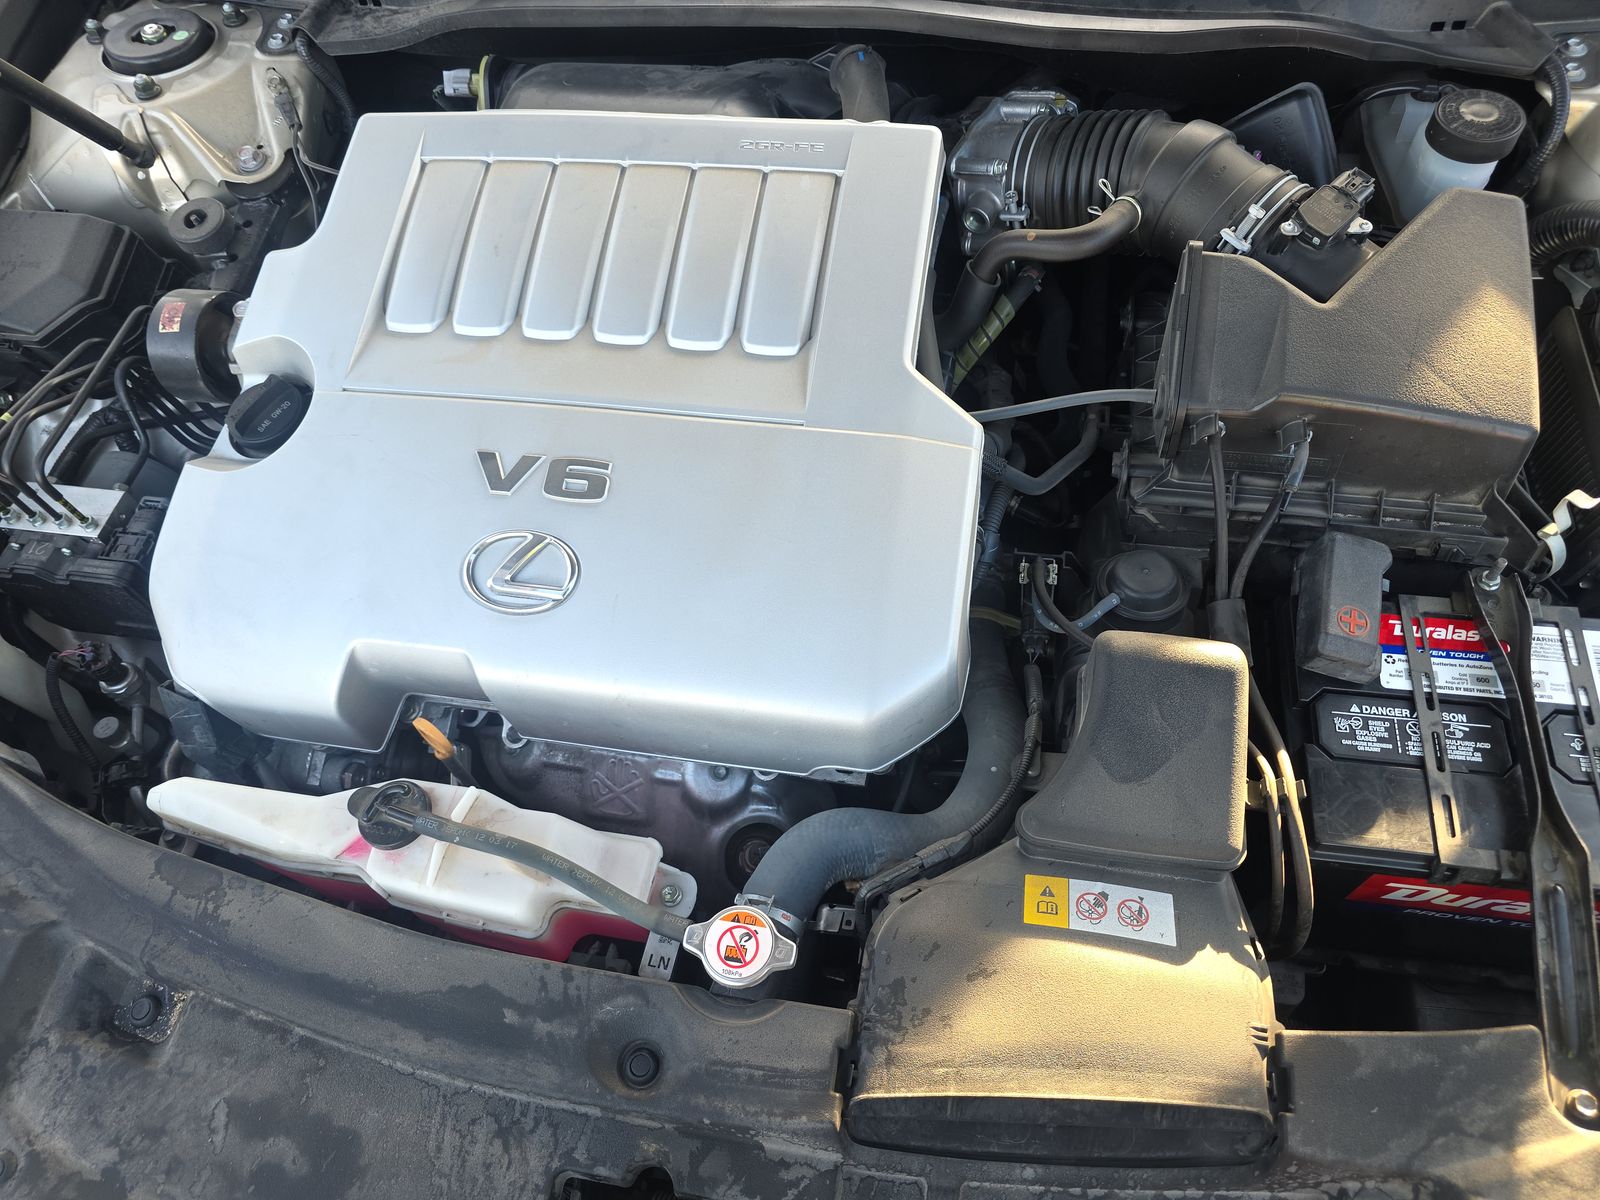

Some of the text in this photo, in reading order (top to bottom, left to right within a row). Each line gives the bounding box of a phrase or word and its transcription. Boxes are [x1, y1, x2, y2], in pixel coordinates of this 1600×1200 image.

[739, 139, 825, 153] 2GR-FE
[257, 419, 272, 433] SAE
[475, 449, 614, 503] V6
[1388, 619, 1480, 642] Duralas
[1449, 651, 1484, 660] TOUGH
[1466, 663, 1493, 671] AutoZone
[1362, 705, 1467, 723] DANGER SON
[1368, 720, 1390, 728] SHIELD
[1369, 725, 1385, 733] EYES
[1356, 730, 1389, 738] EXPLOSIVE
[1356, 735, 1377, 743] GASES
[1445, 739, 1475, 747] SULFURIC
[415, 816, 439, 831] WATER
[542, 852, 569, 872] WATER
[1380, 882, 1532, 916] Dura
[663, 913, 688, 927] WATER
[1403, 908, 1503, 924] PROVEN
[647, 953, 671, 971] LN
[721, 967, 743, 978] 108kPa
